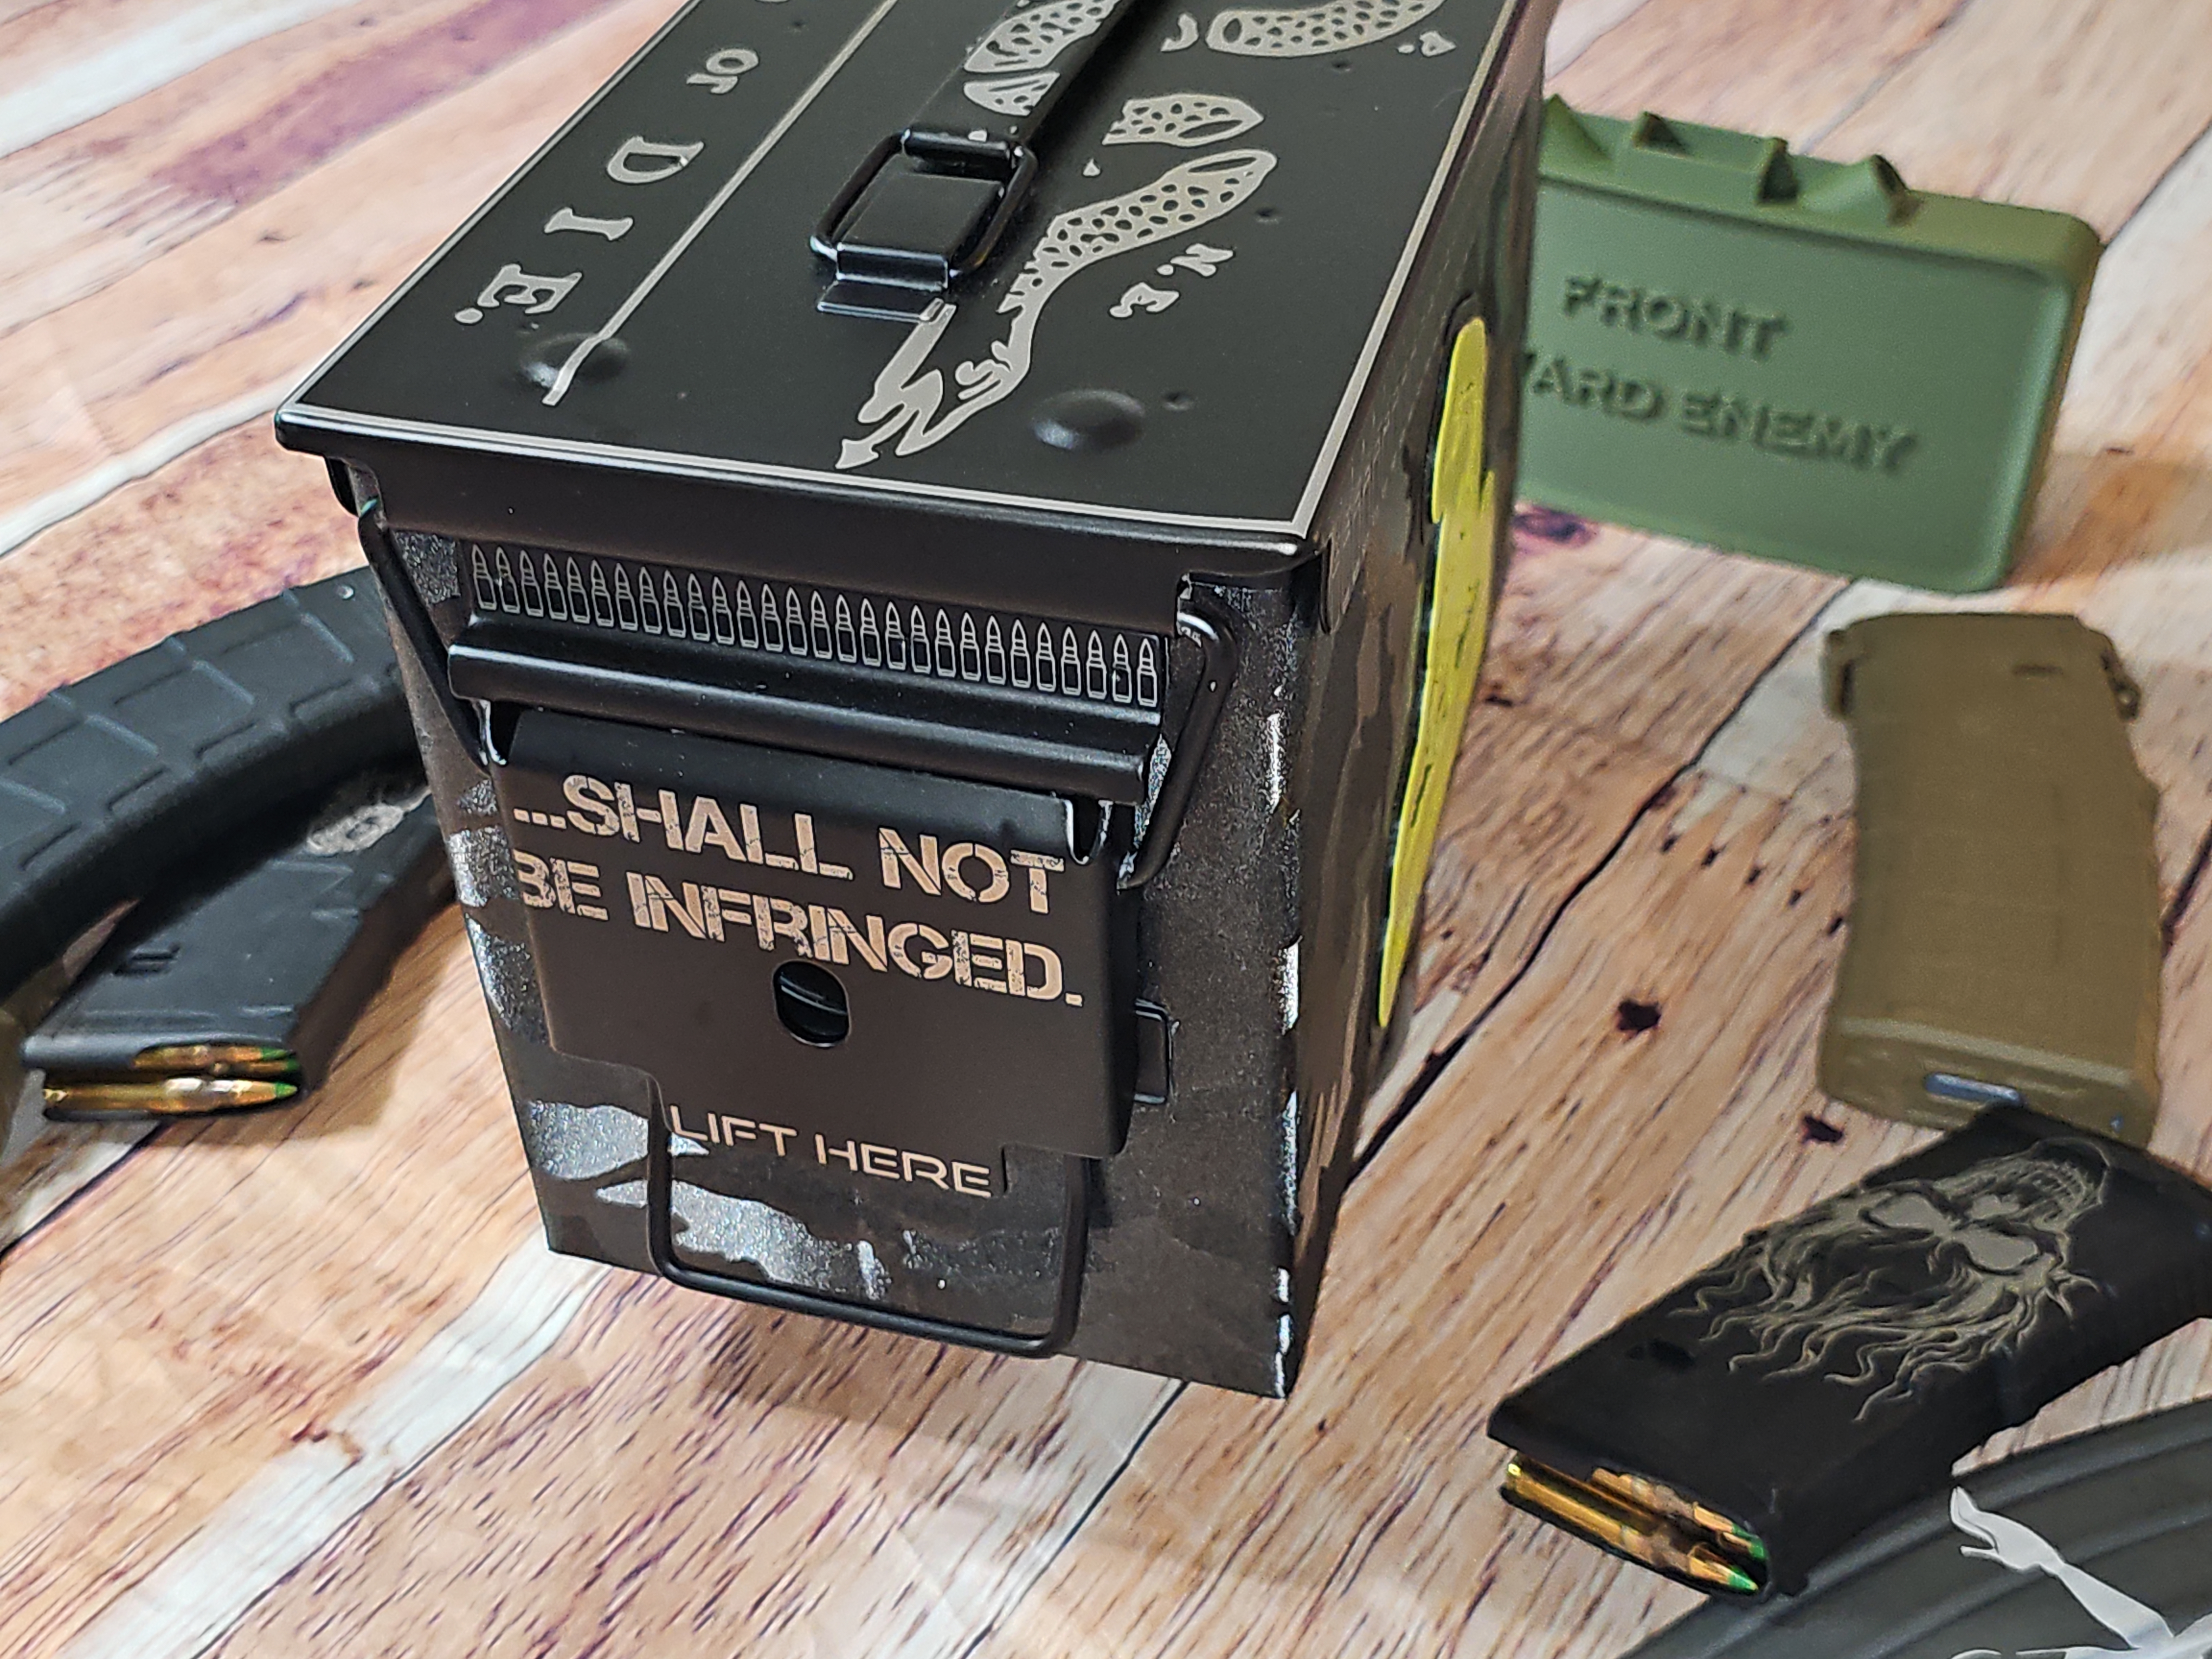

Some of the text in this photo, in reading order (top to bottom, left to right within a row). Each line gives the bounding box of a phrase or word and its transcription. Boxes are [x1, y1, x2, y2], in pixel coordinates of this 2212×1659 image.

[686, 48, 758, 94] or
[1564, 274, 1789, 360] FRONT
[1681, 390, 1918, 474] ENEMY
[878, 827, 1065, 915] NOT
[511, 848, 1083, 1007] BE INFRINGED.
[670, 1105, 992, 1199] LIFT HERE
